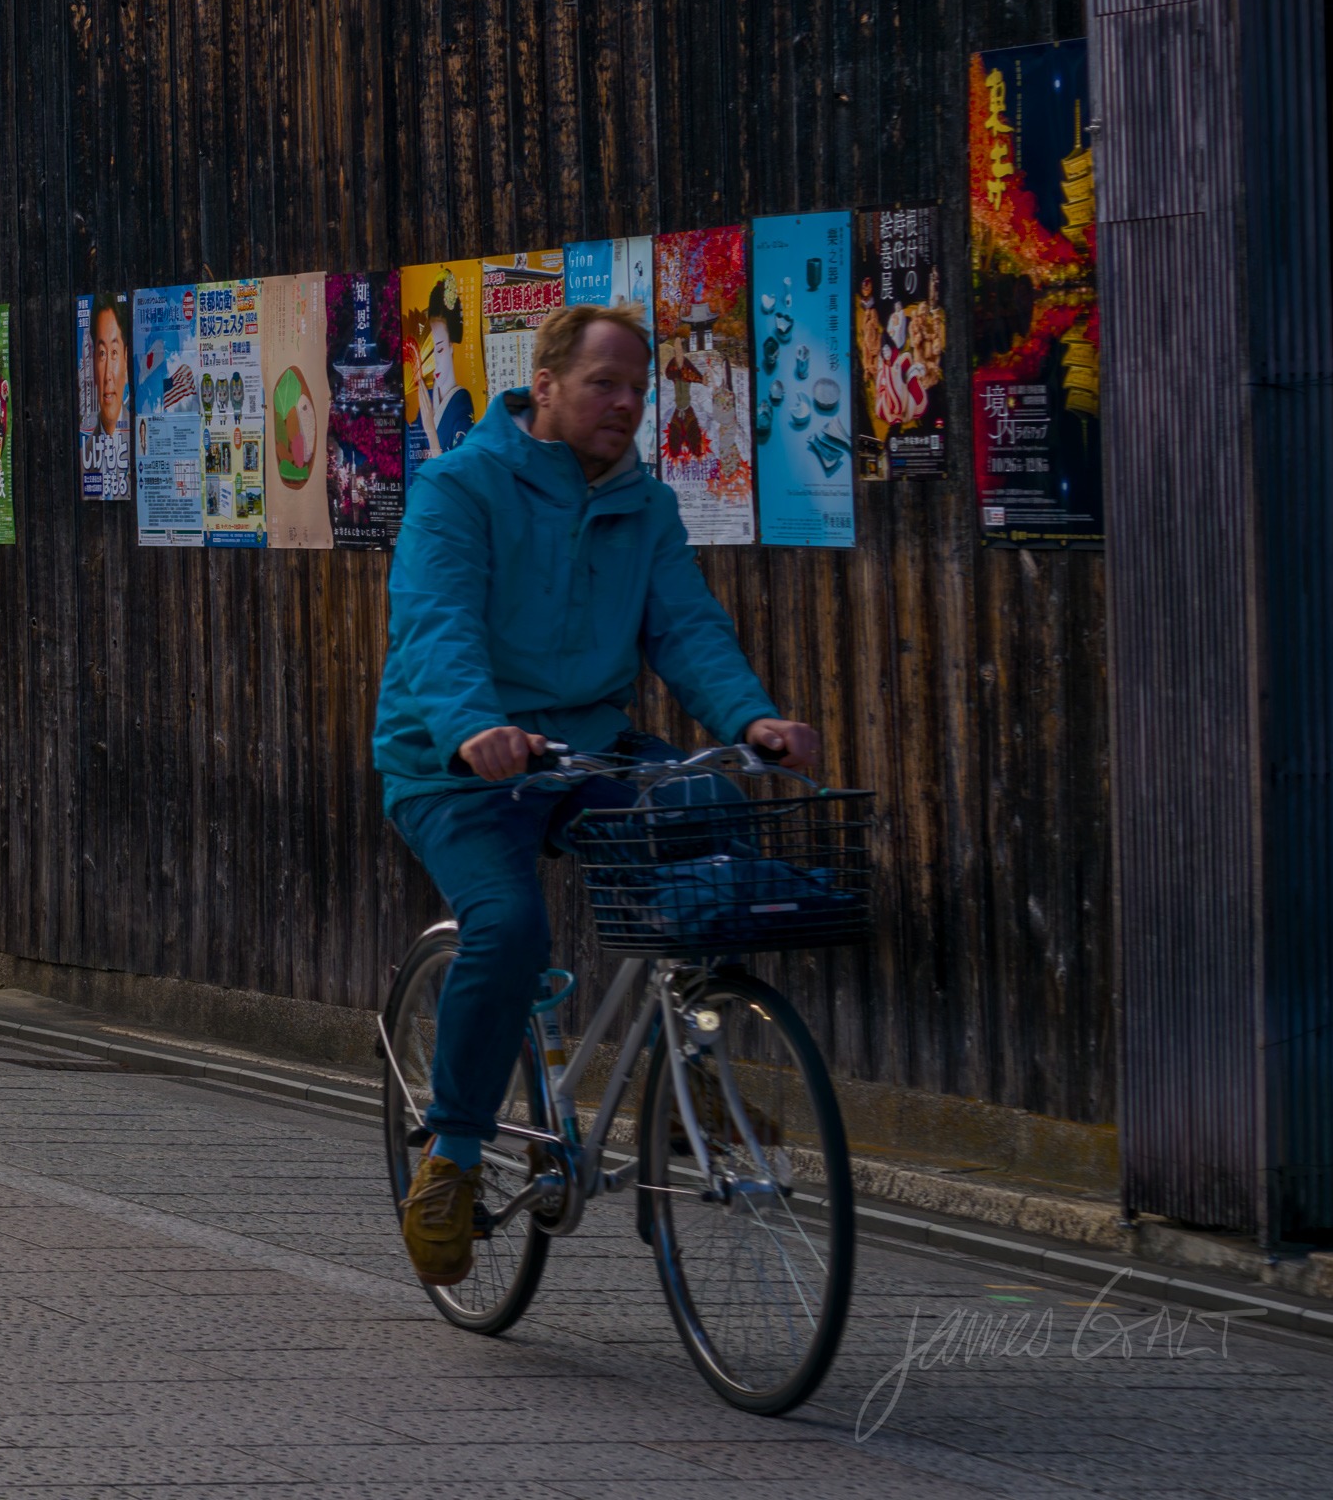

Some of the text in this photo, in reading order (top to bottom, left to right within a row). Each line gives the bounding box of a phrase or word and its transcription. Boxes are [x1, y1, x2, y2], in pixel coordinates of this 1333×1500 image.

[568, 250, 593, 268] Gion
[569, 271, 610, 289] Corner
[200, 314, 244, 337] 防災フェスタ
[356, 281, 367, 358] 知恩院
[979, 384, 1016, 445] 境内
[82, 434, 129, 470] しげもと
[103, 473, 128, 496] まもる
